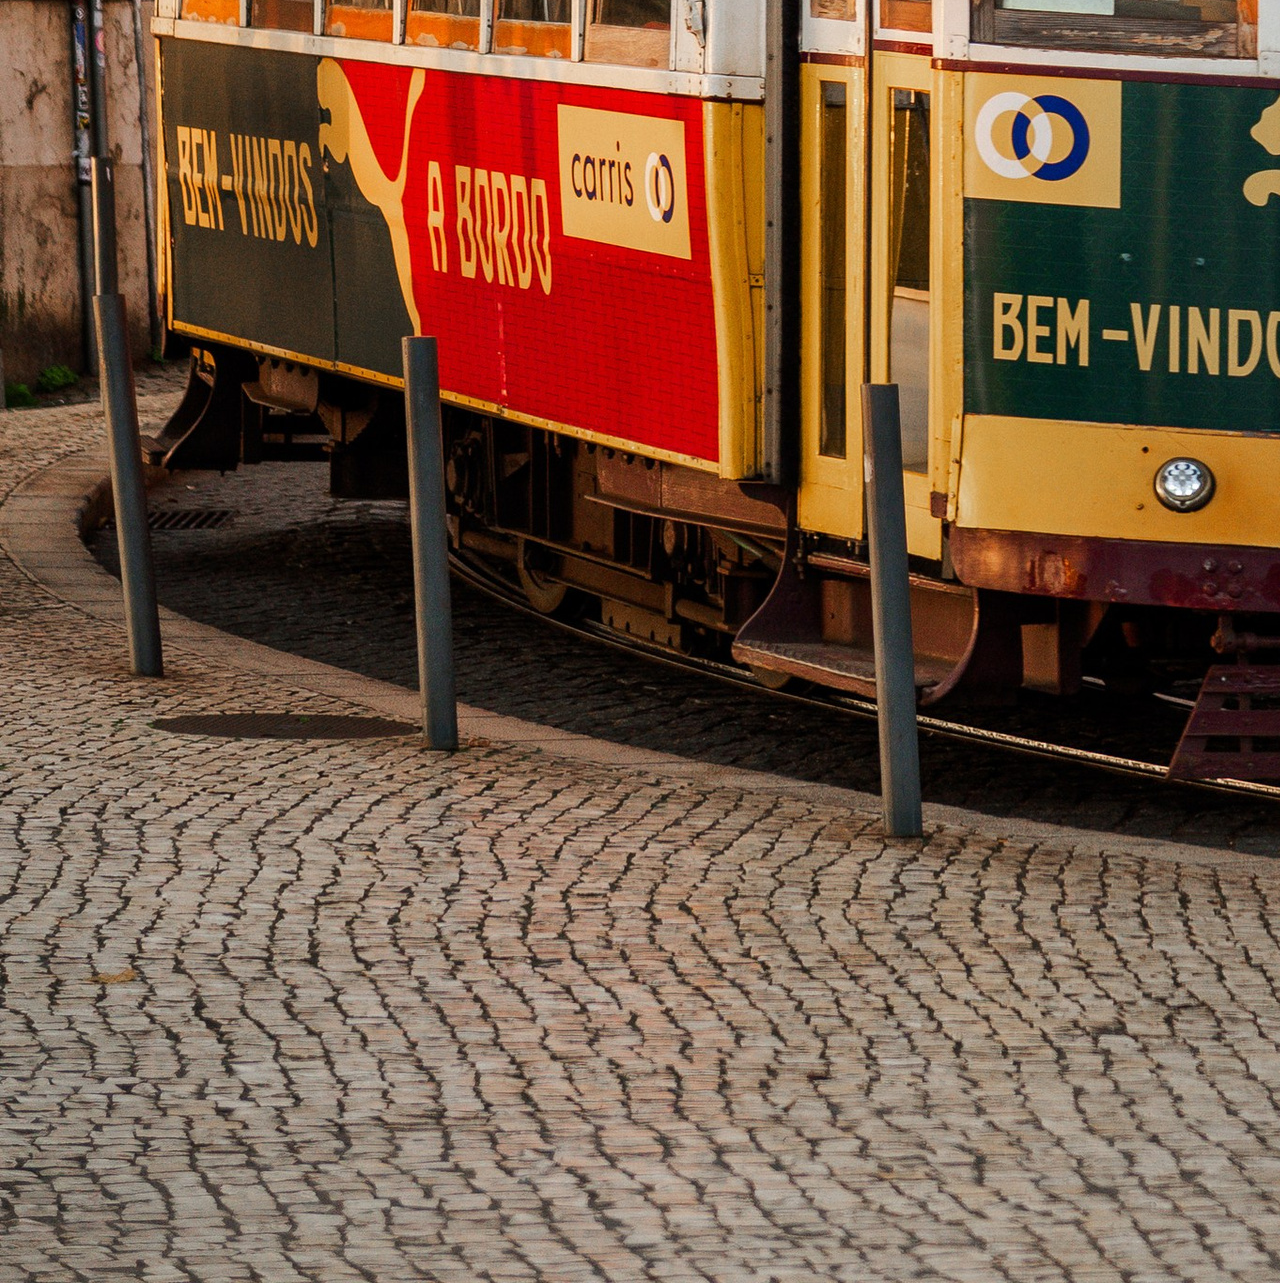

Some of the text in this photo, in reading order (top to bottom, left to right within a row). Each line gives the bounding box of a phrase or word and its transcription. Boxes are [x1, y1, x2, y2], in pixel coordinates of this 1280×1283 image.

[571, 140, 634, 207] carris
[427, 160, 448, 274] A
[455, 164, 552, 295] BORDO
